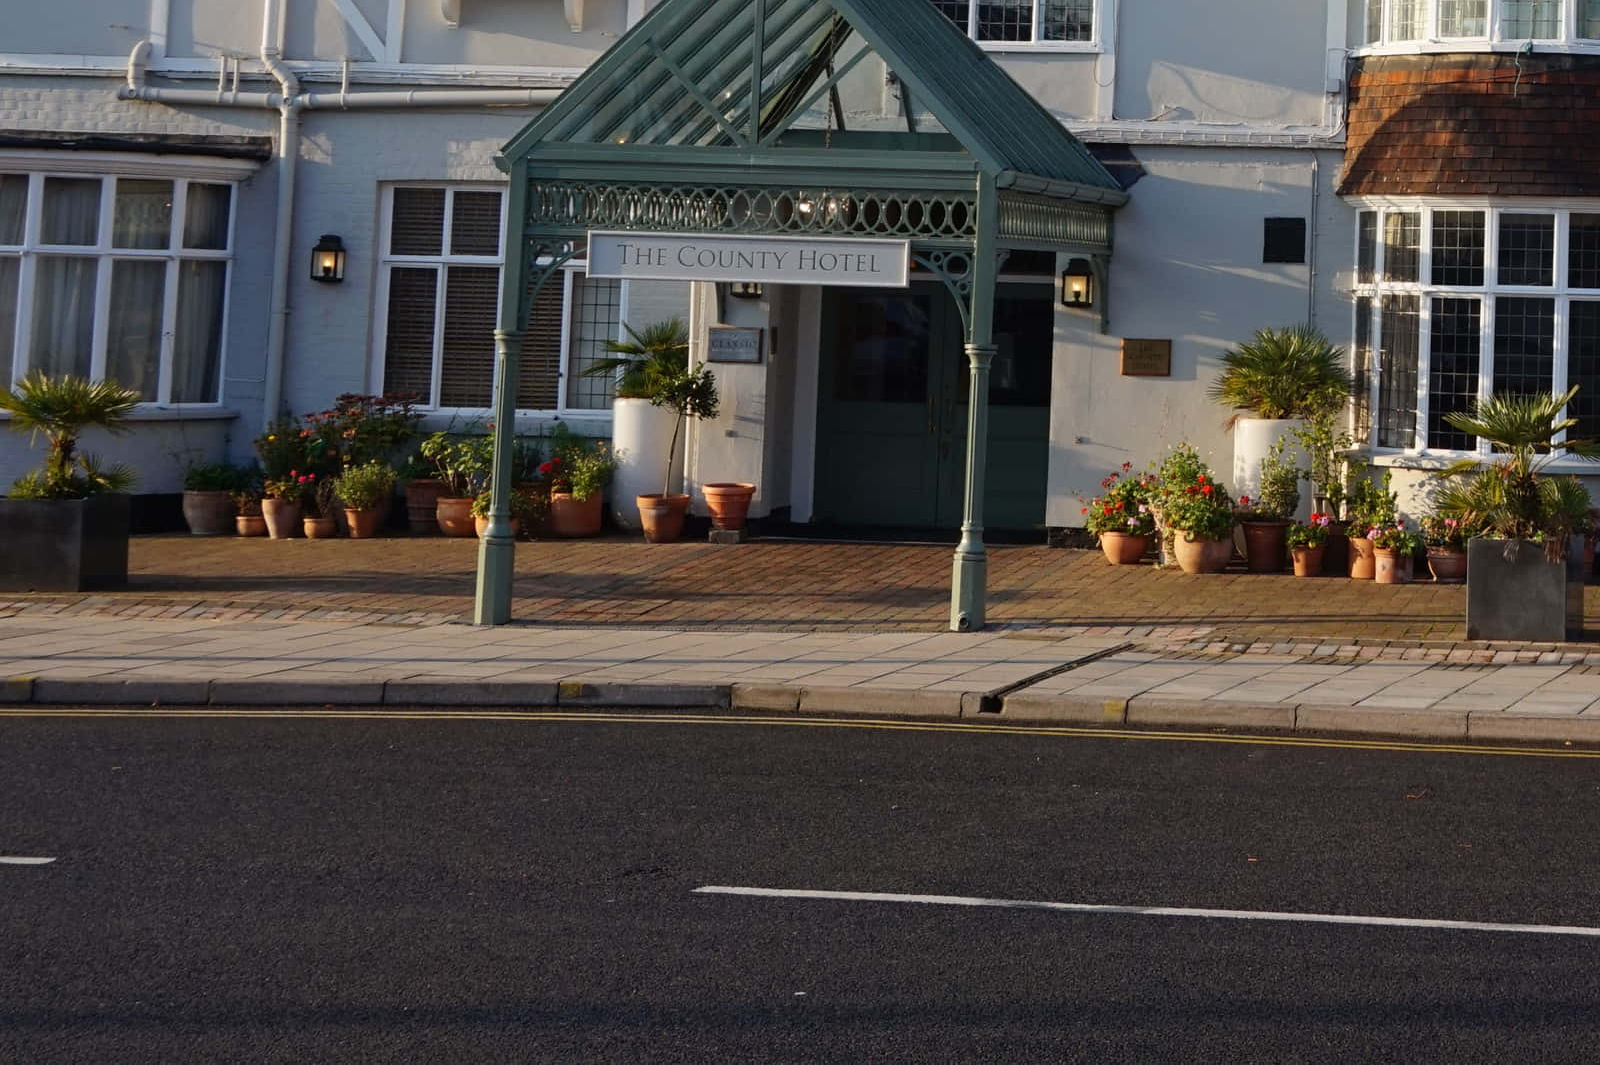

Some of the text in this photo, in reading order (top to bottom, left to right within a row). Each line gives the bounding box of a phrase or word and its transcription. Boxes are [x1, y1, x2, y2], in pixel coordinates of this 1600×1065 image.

[617, 244, 881, 273] THE COUNTY HOTEL
